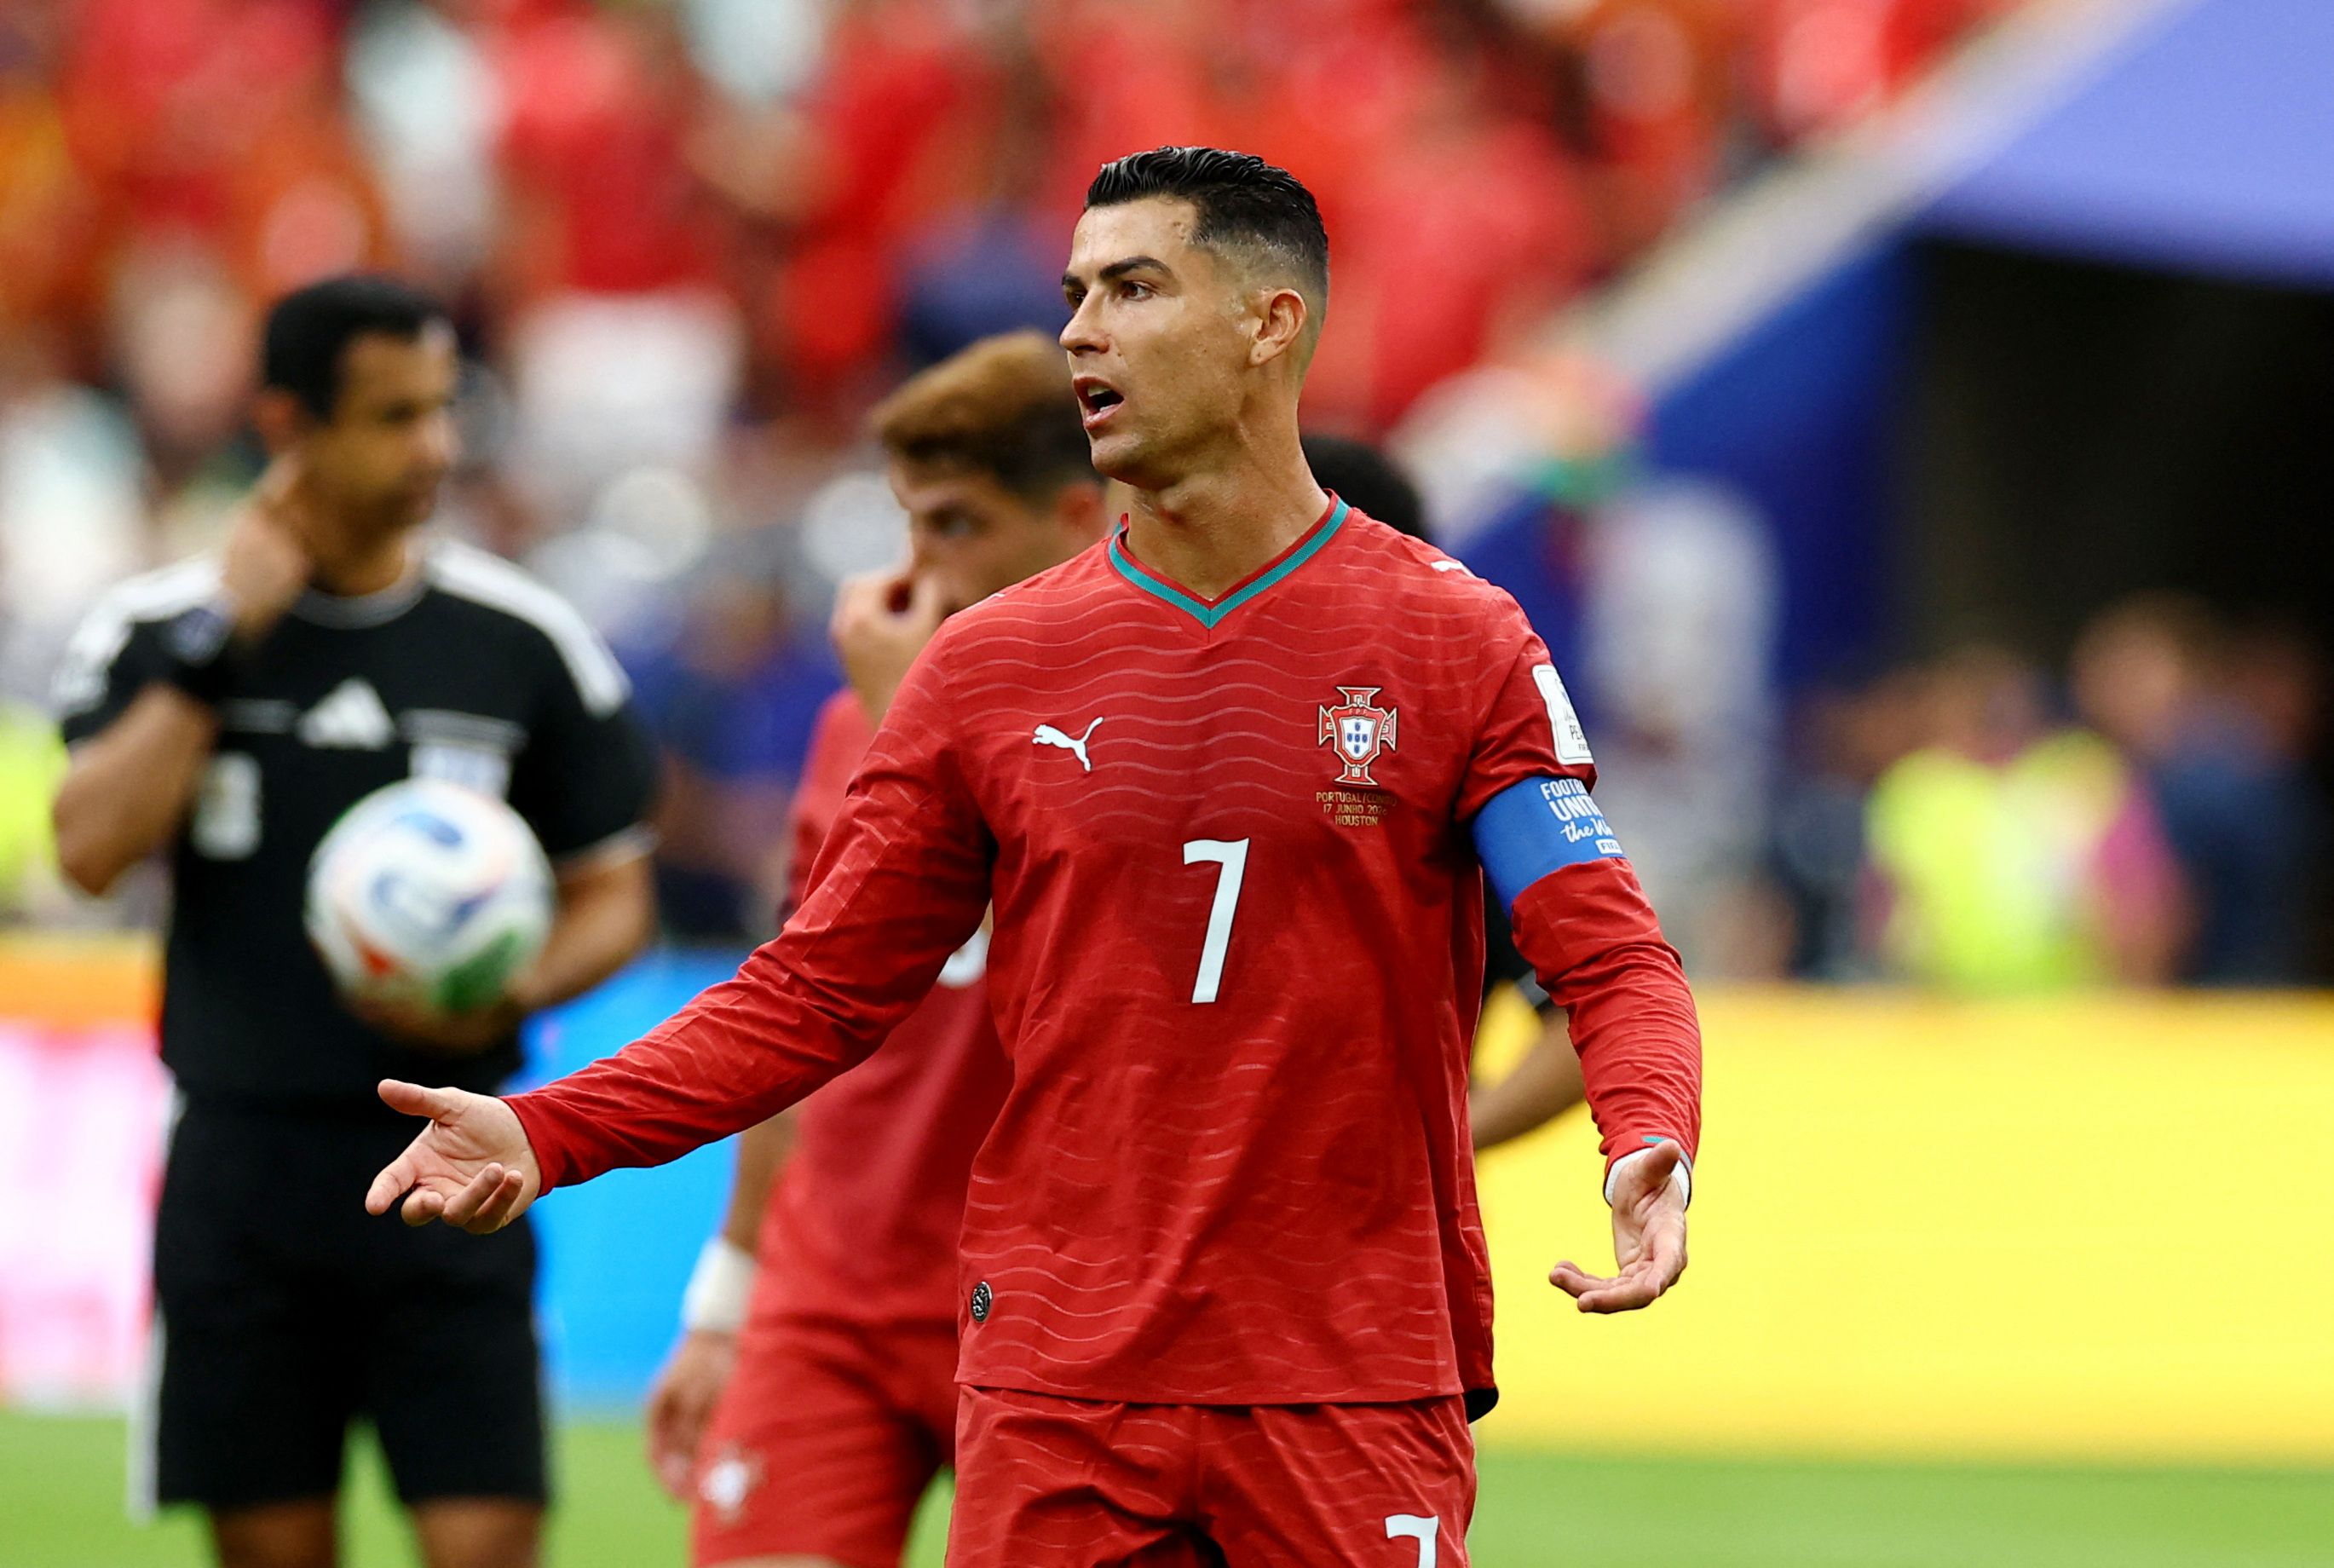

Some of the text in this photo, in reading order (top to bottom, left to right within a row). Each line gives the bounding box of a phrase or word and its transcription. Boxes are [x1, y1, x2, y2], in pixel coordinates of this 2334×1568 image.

[1323, 804, 1333, 814] 17
[1336, 804, 1364, 815] JUNHO
[1334, 815, 1379, 827] HOUSTON
[1559, 821, 1594, 843] the
[1183, 838, 1250, 1004] 7
[1385, 1513, 1438, 1568] 7
